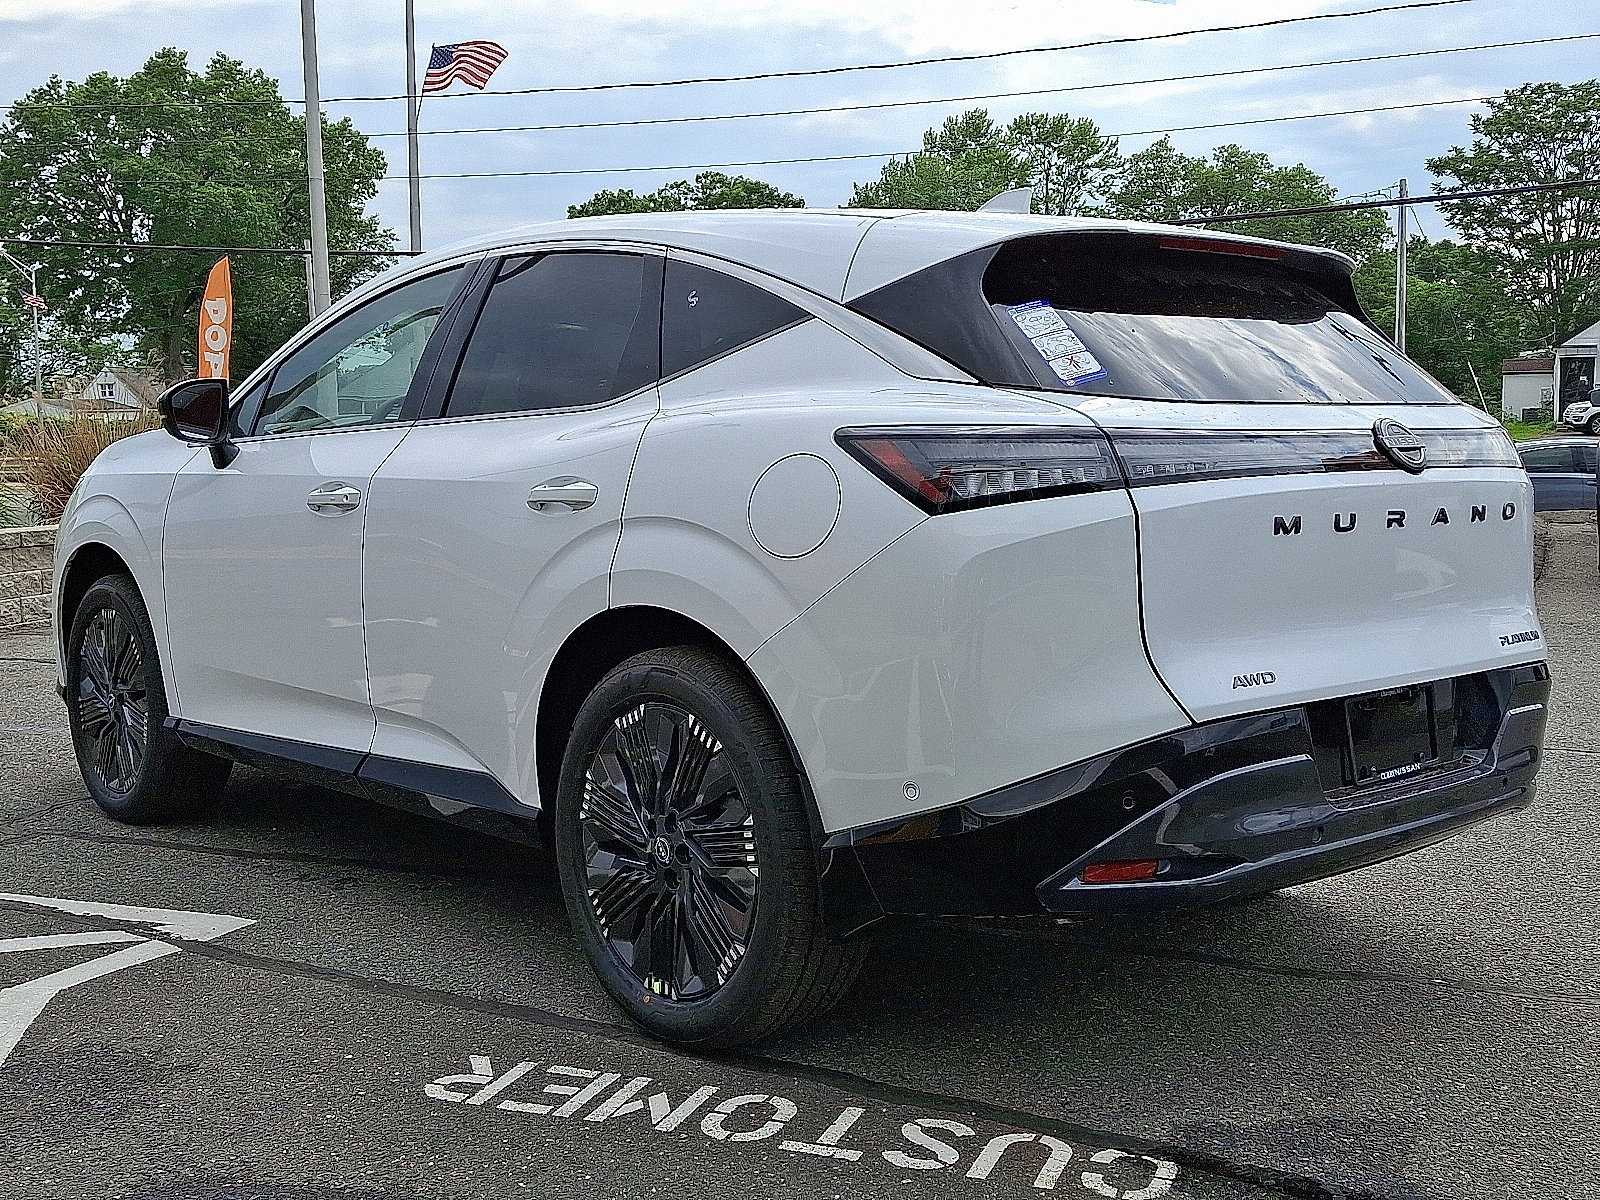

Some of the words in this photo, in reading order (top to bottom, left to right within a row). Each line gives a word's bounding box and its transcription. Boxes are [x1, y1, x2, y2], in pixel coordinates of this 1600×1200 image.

[1273, 502, 1516, 536] MURANO
[1232, 671, 1277, 689] AWD
[423, 1054, 1180, 1200] CUSTOMER
